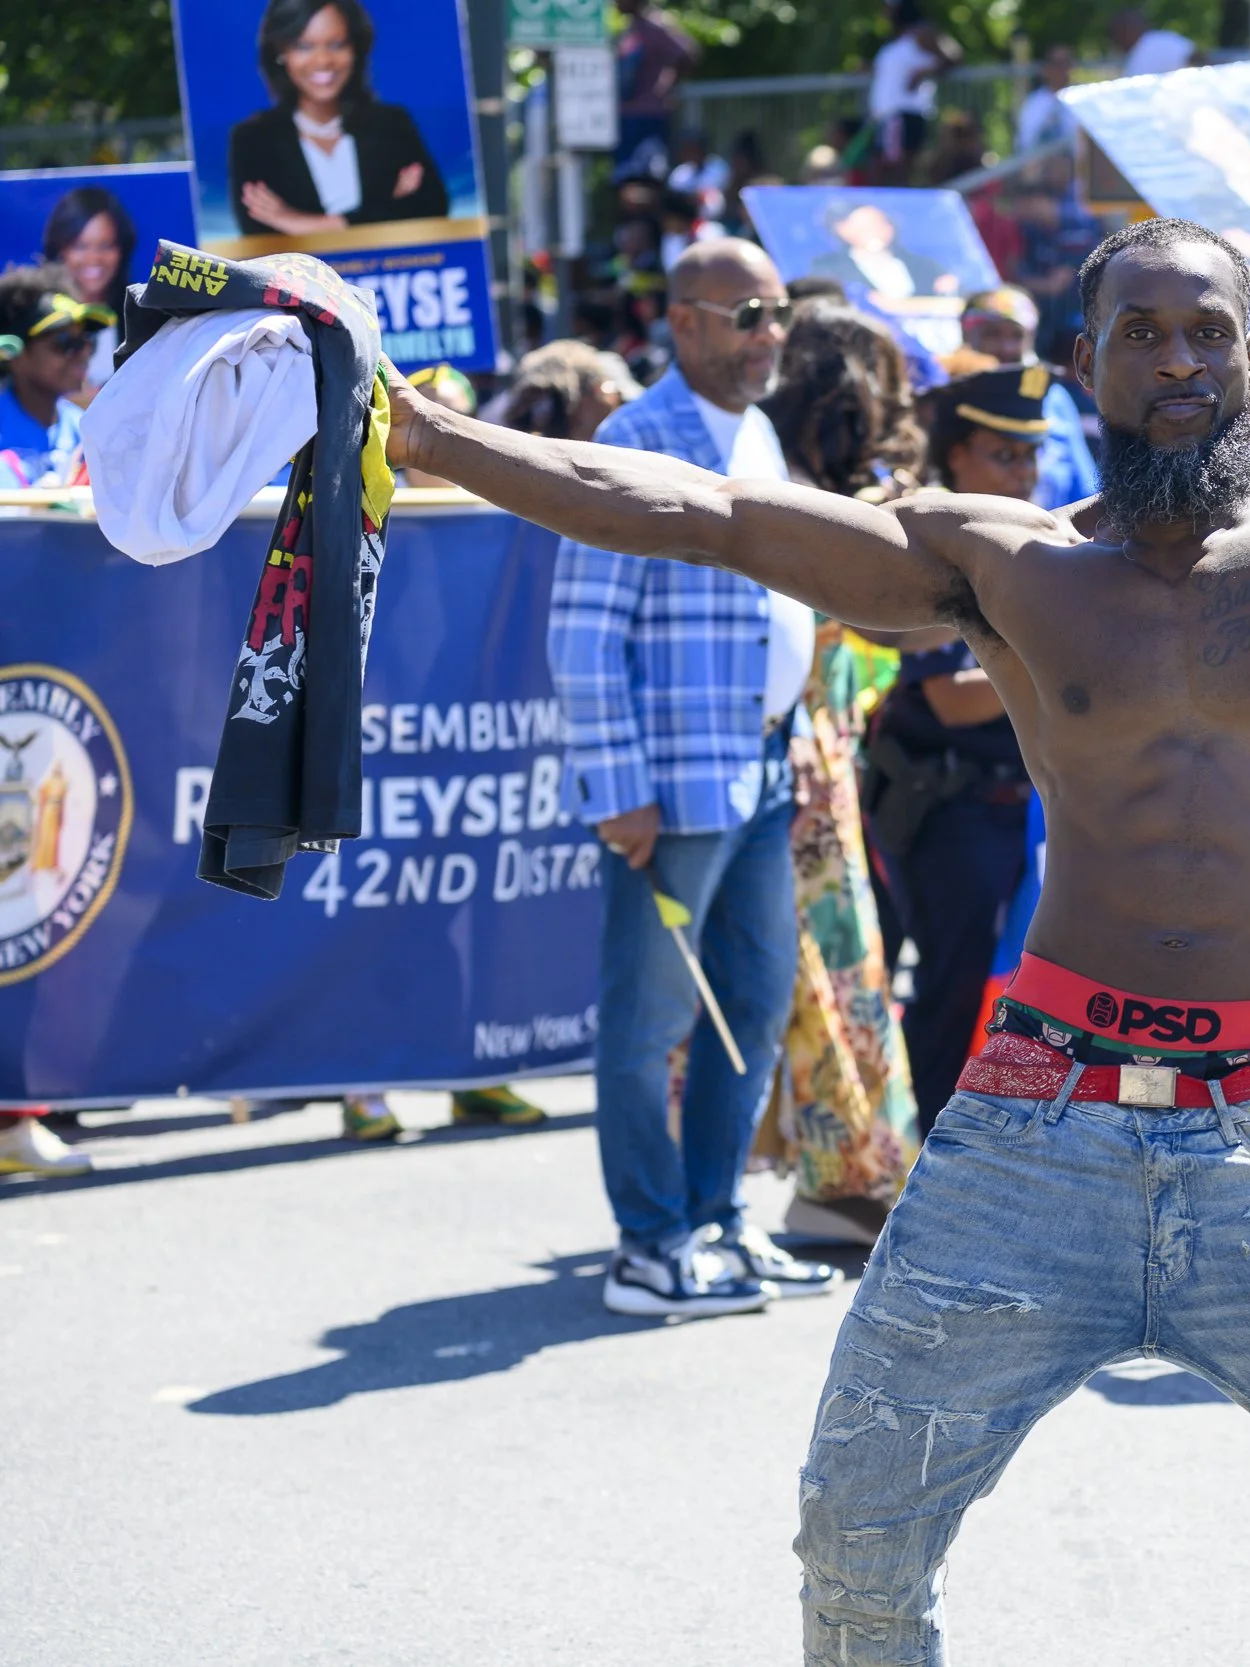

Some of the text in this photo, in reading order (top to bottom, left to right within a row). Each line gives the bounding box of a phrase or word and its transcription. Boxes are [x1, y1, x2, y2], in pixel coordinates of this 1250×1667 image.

[172, 251, 230, 281] THE
[493, 839, 602, 903] DISTR
[1117, 998, 1222, 1044] PSD
